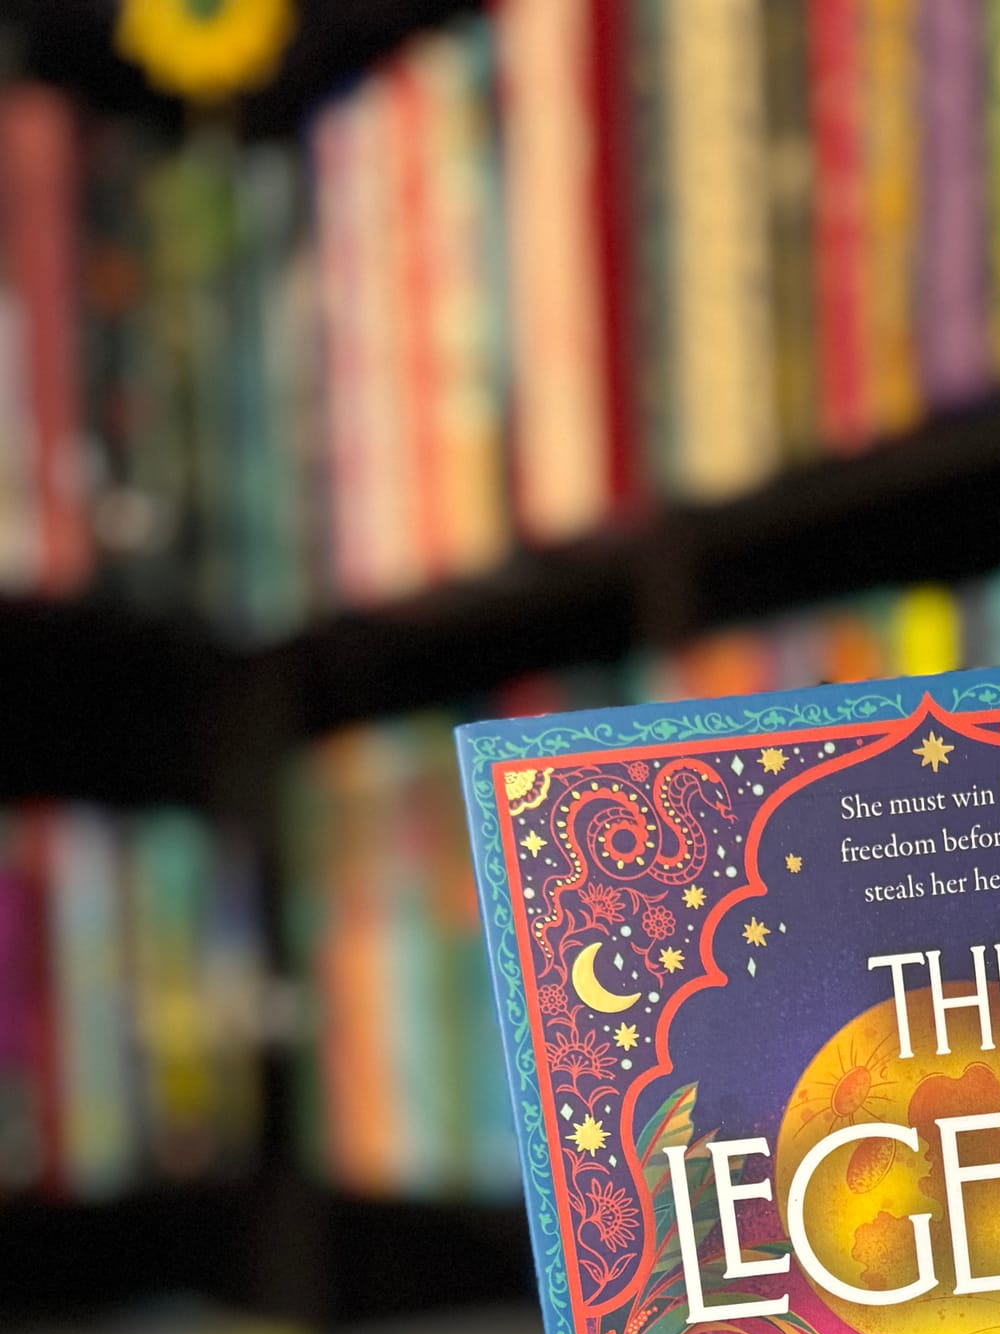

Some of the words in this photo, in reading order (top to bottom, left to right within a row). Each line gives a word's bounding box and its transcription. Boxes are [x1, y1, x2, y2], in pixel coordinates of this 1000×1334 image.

[841, 794, 883, 820] She
[889, 793, 945, 815] must
[952, 784, 995, 807] win
[841, 833, 936, 863] freedom
[864, 874, 924, 902] steals
[930, 872, 967, 896] her
